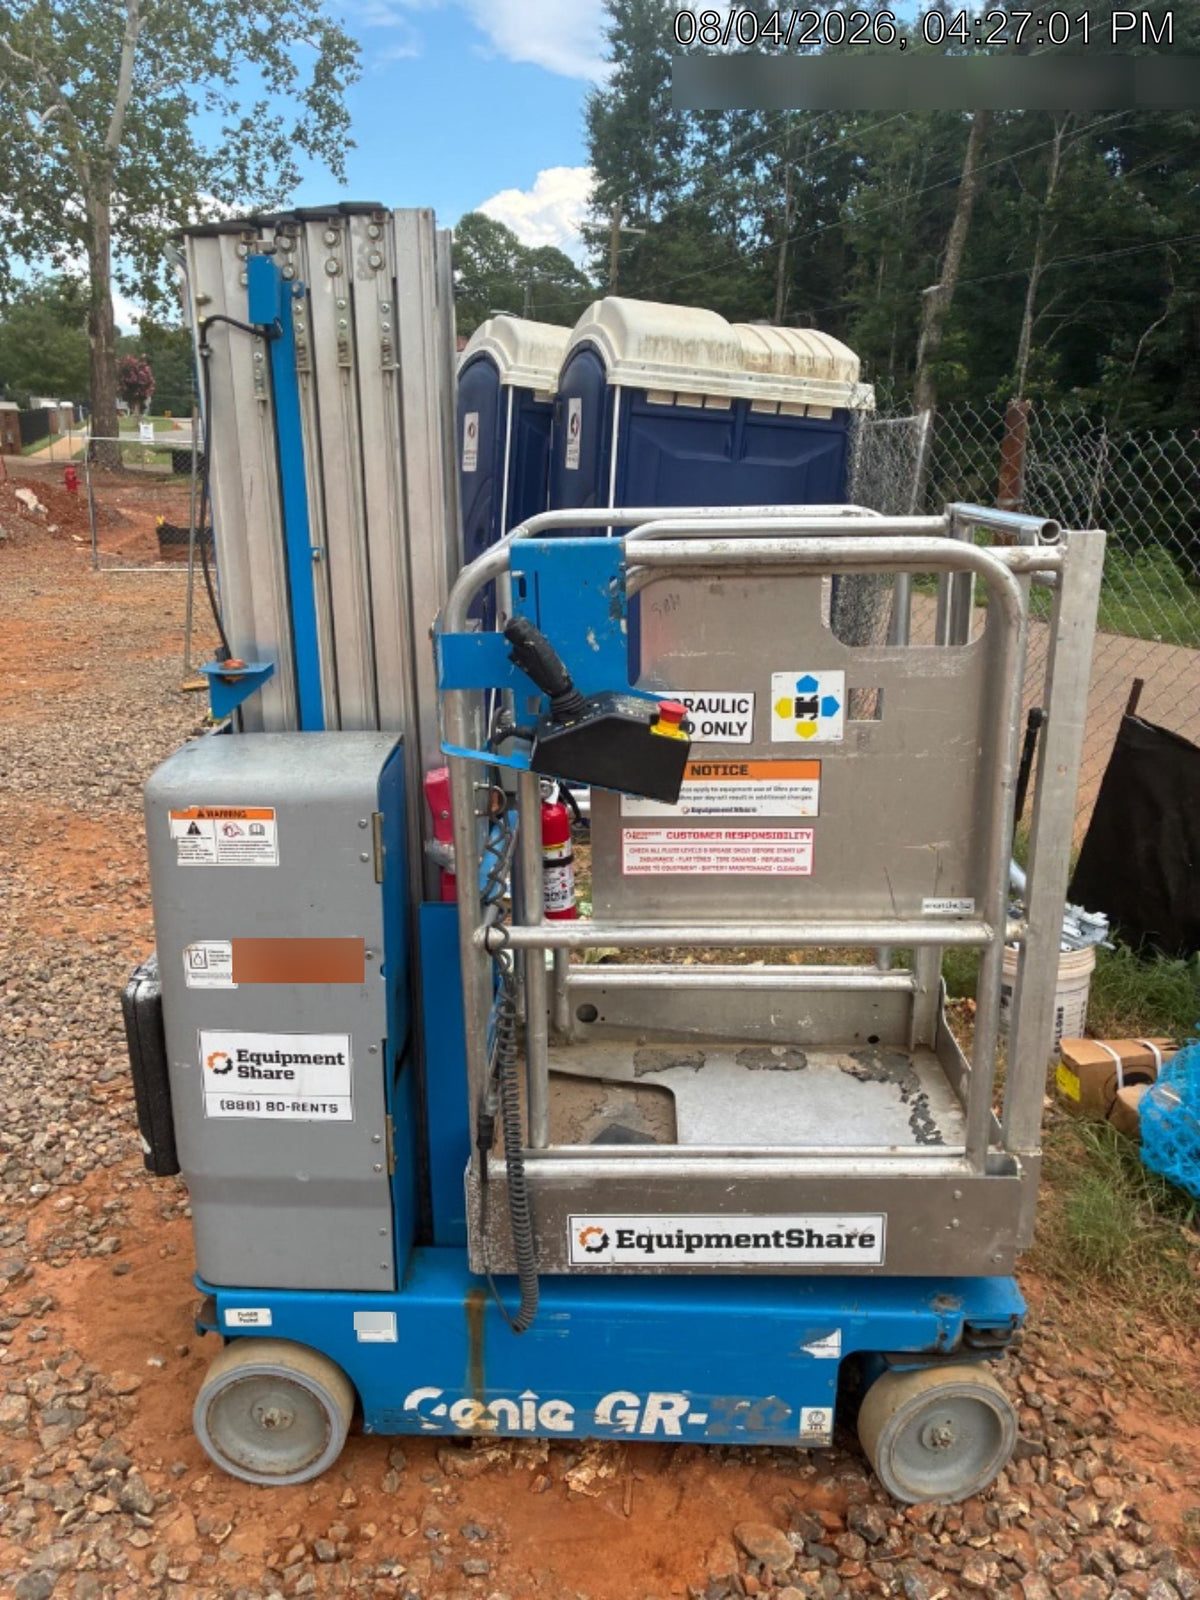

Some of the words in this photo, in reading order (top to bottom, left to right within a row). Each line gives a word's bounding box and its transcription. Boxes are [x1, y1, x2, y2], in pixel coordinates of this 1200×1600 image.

[701, 721, 748, 736] ONLY
[690, 764, 749, 776] NOTICE
[666, 831, 722, 839] CUSTOMER
[724, 831, 812, 839] RESPONSIBILITY
[236, 1049, 346, 1067] Equipment
[237, 1066, 295, 1080] Share
[220, 1099, 261, 1112] (888)
[615, 1228, 876, 1254] EquipmentShare
[403, 1386, 575, 1431] Genie
